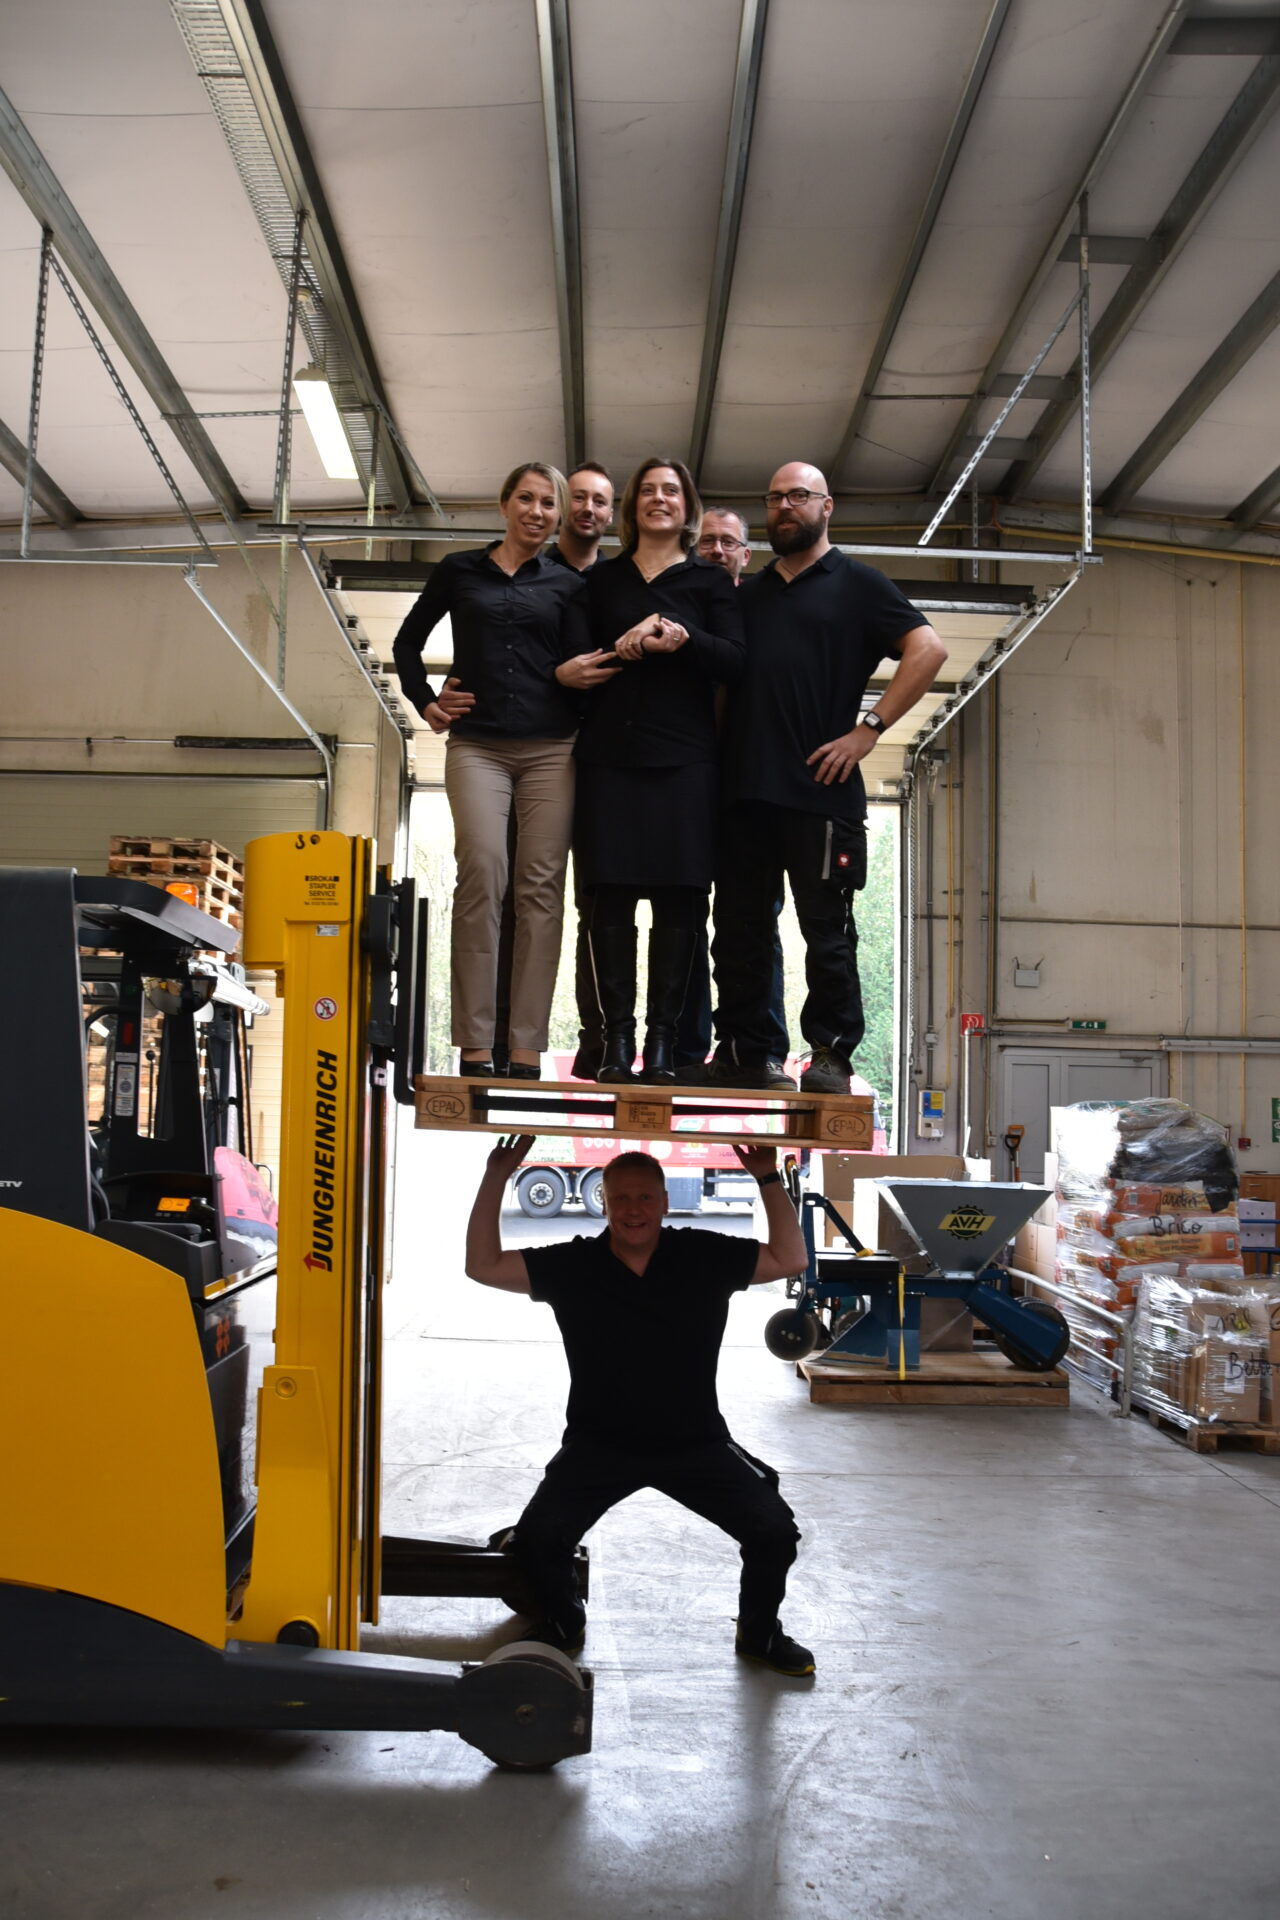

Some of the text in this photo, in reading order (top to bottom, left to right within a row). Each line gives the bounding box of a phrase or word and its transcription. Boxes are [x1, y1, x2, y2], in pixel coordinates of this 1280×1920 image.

[432, 1100, 459, 1113] EPAL
[312, 1049, 338, 1272] JUNGHEINRICH
[948, 1216, 986, 1229] AVH
[1148, 1213, 1204, 1236] Brico
